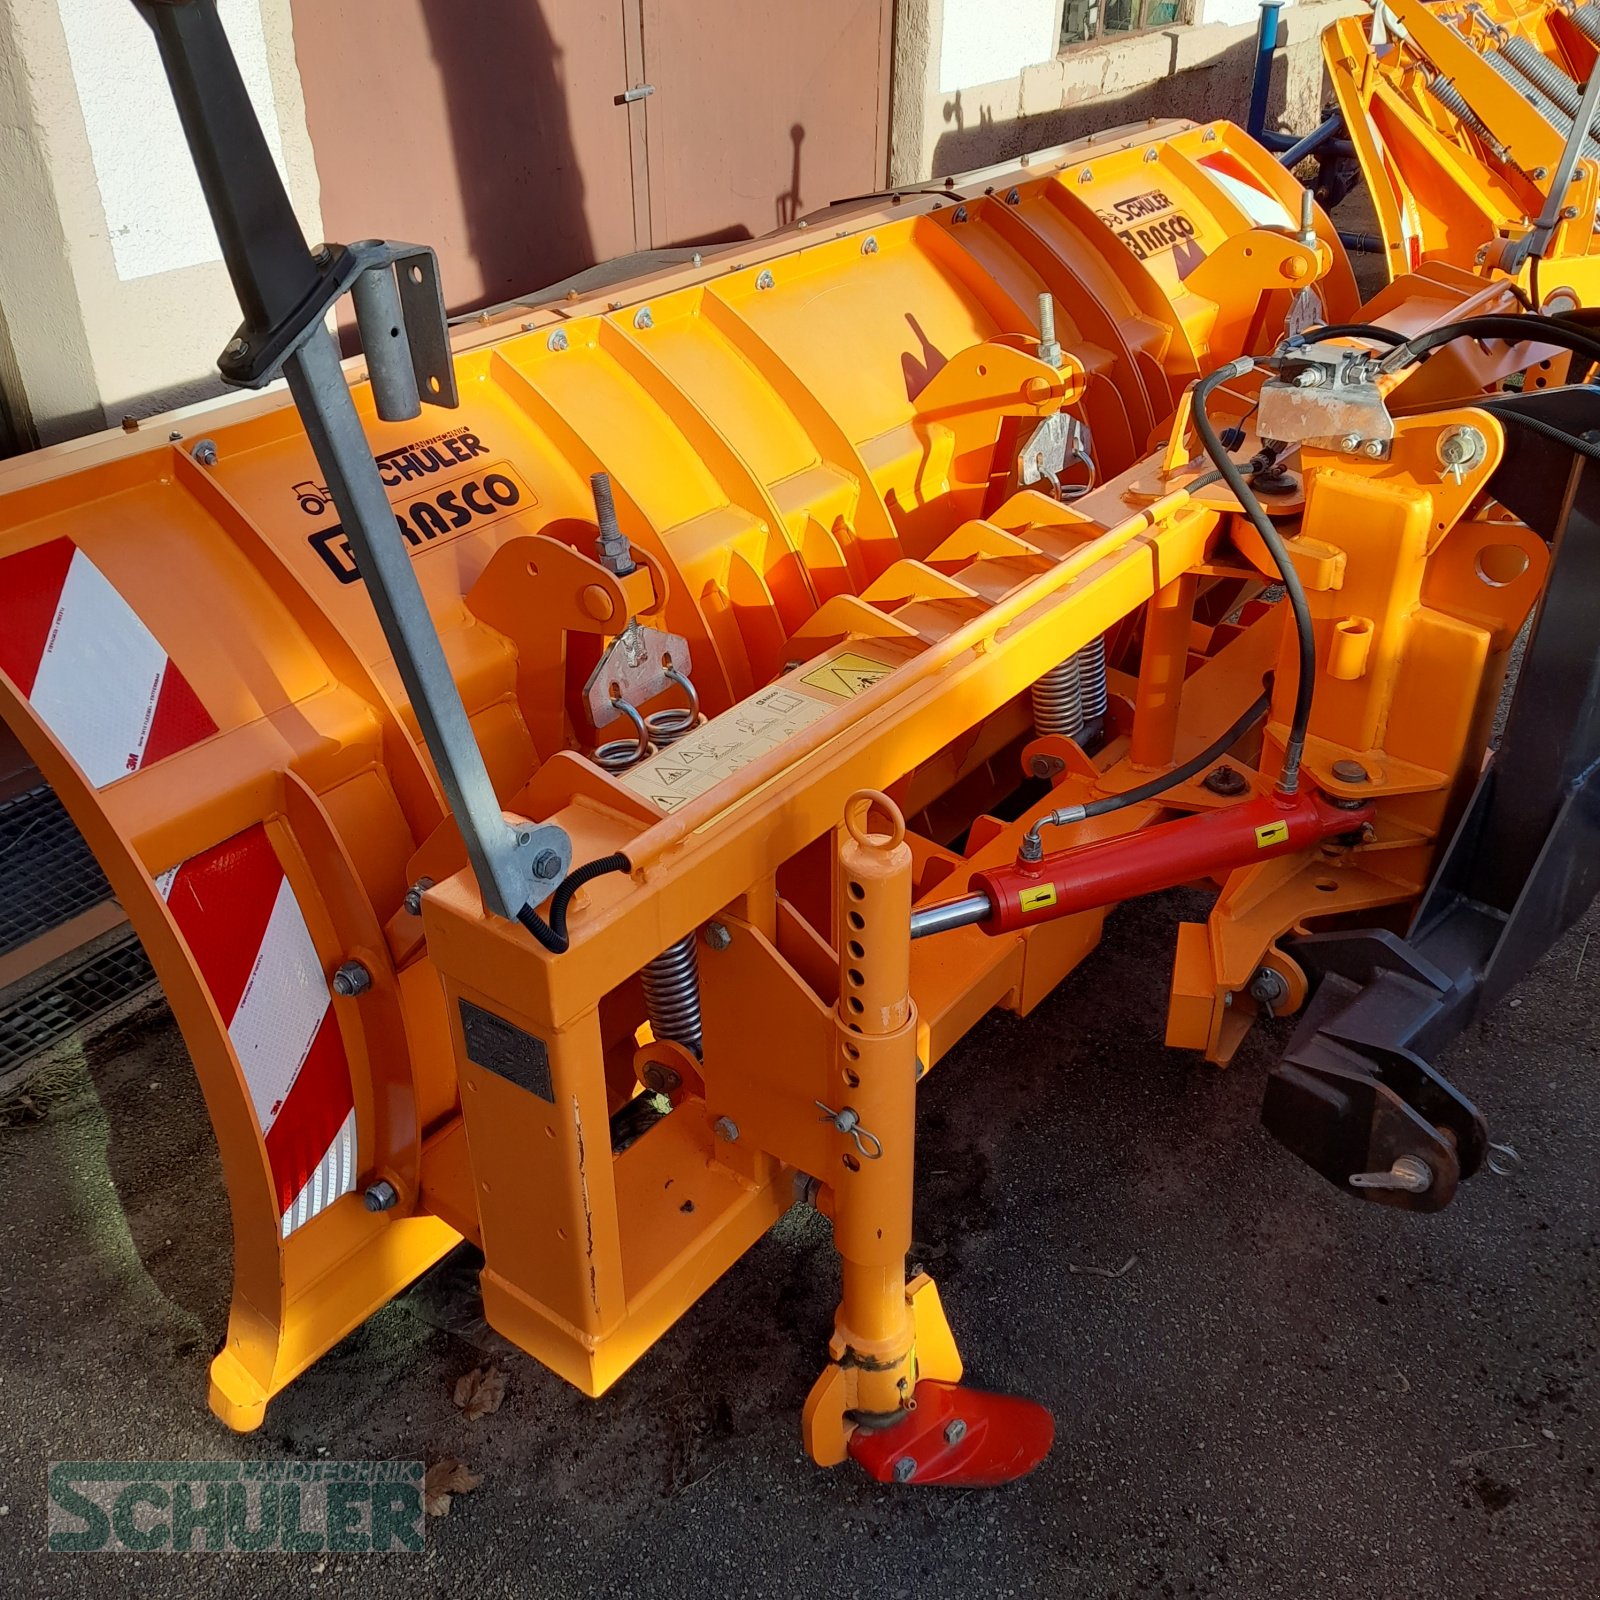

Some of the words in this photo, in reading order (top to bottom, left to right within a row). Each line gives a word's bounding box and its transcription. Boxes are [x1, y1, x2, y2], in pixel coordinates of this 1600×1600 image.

[1113, 193, 1174, 222] SCHULER
[1136, 215, 1195, 251] RASCO
[374, 433, 490, 487] CHULER
[126, 753, 139, 771] 3M
[270, 1100, 282, 1116] 3M
